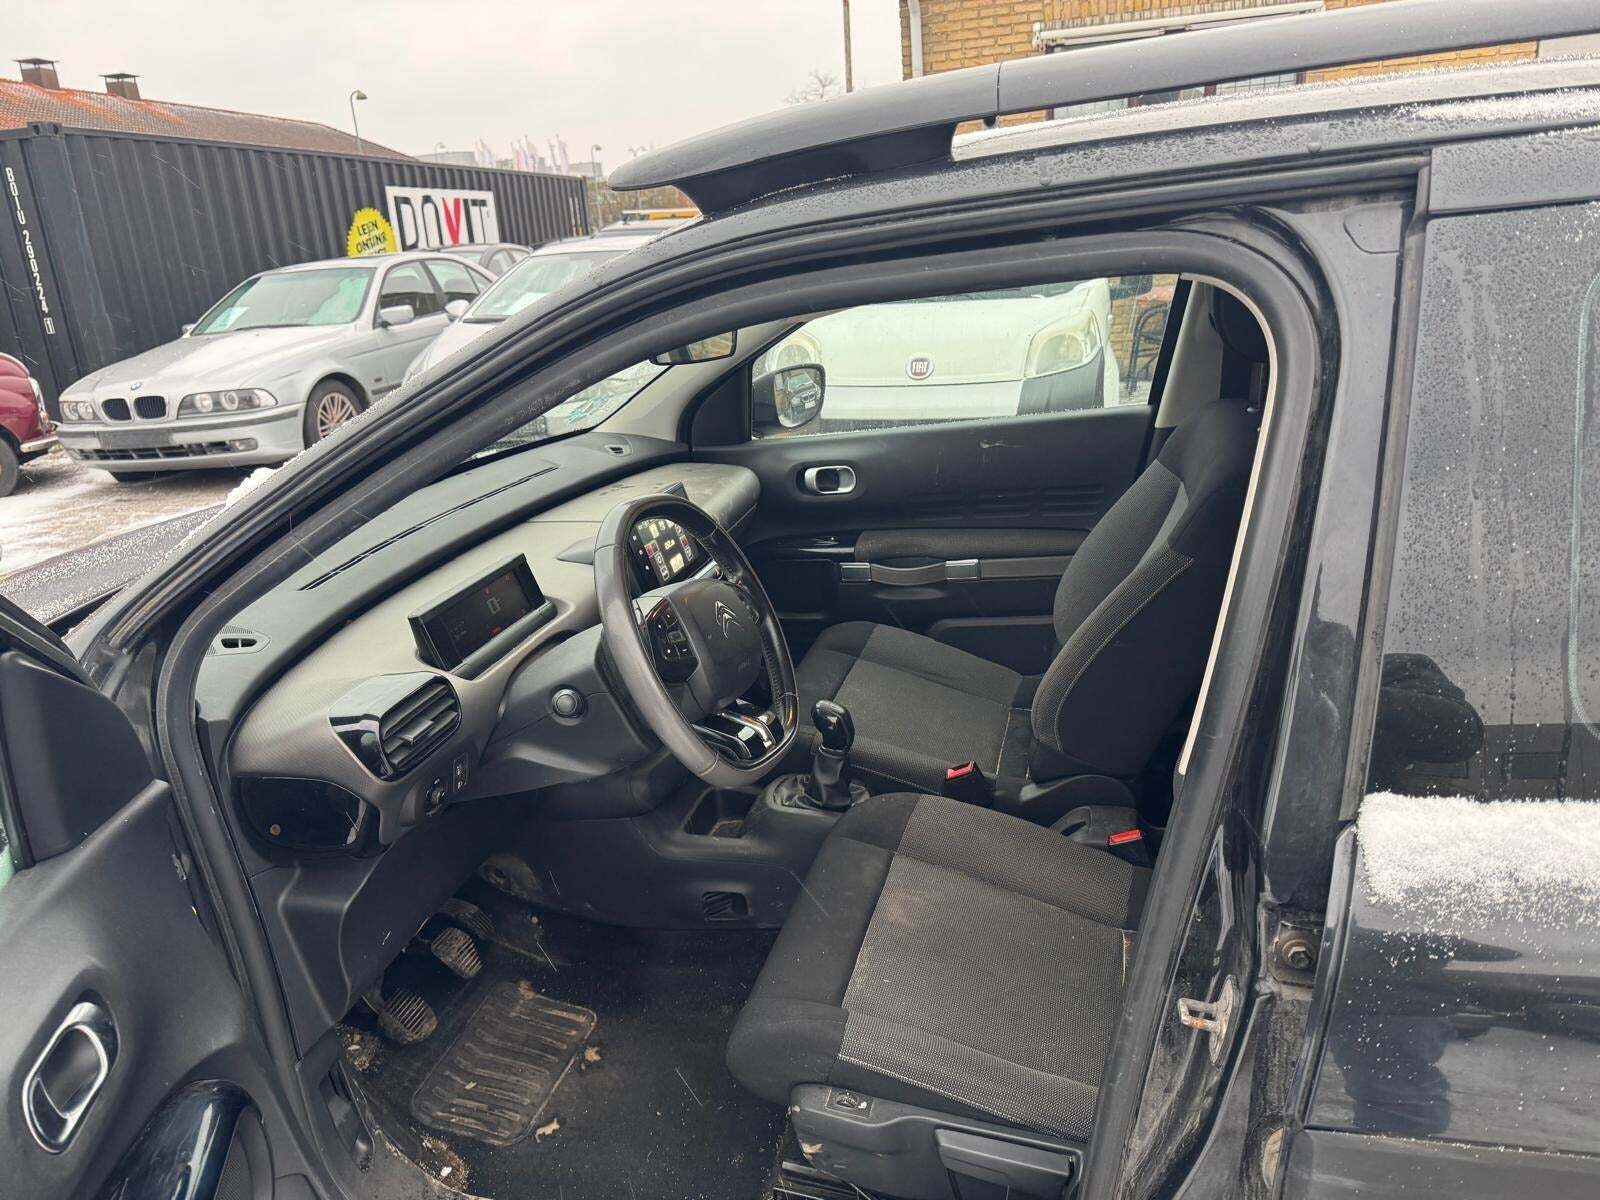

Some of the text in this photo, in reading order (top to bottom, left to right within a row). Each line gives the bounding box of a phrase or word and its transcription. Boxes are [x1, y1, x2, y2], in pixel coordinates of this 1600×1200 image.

[394, 195, 487, 252] DOVIT
[22, 230, 49, 313] 290224
[912, 361, 929, 374] FIAT
